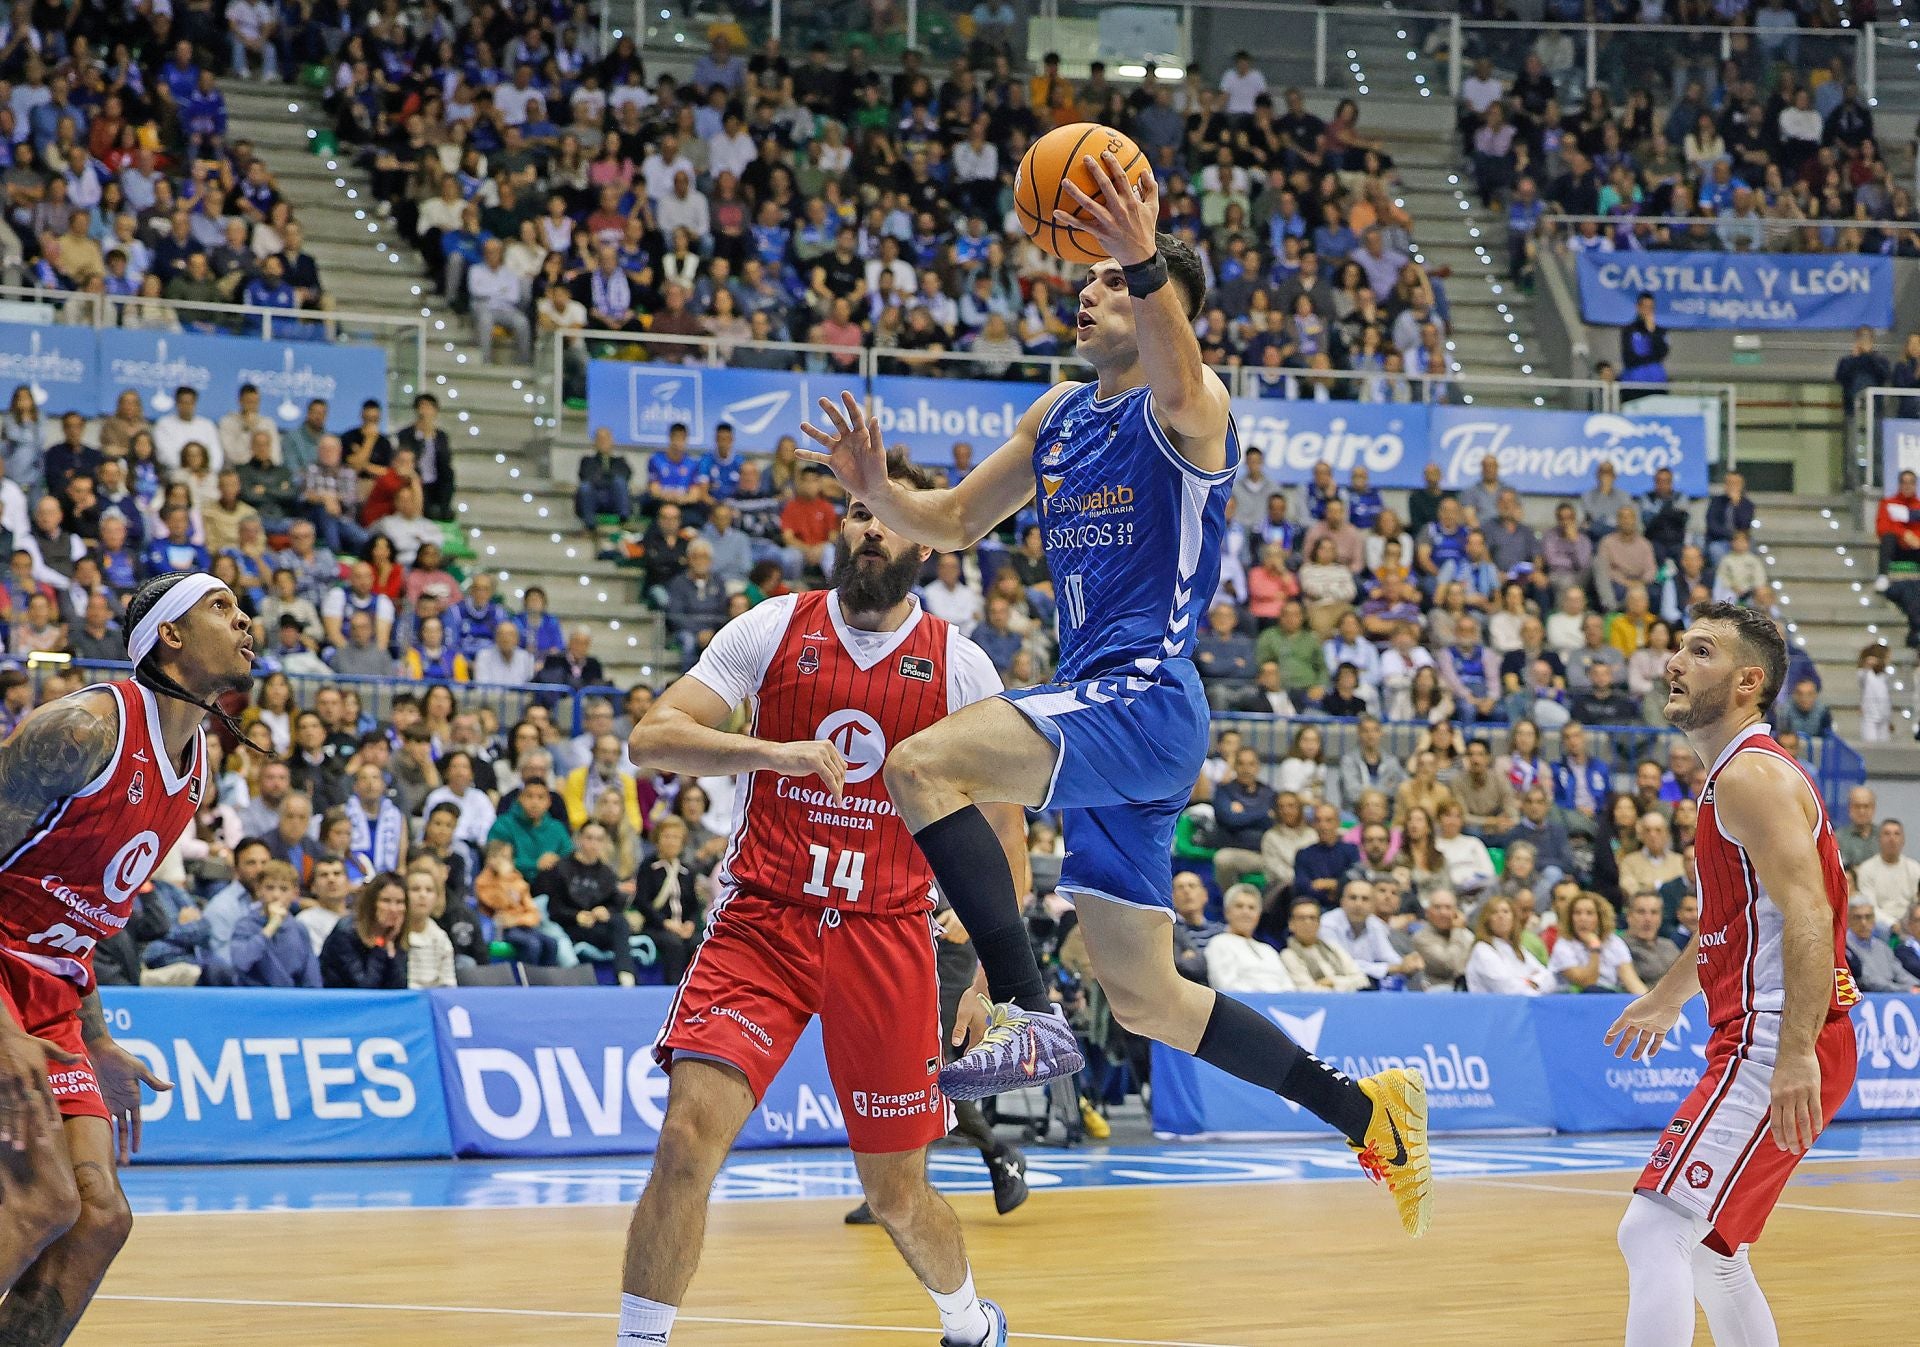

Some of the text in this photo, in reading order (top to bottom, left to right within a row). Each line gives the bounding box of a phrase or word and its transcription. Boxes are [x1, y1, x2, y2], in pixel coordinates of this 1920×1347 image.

[1599, 259, 1871, 298] CASTILLA Y LEÓN
[1117, 522, 1134, 533] 20
[1117, 534, 1134, 545] 31
[902, 668, 930, 679] endesa
[807, 810, 874, 831] ZARAGOZA
[802, 843, 866, 902] 14
[710, 1005, 773, 1047] azulmarino
[870, 1089, 926, 1107] Zaragoza
[871, 1102, 927, 1118] DEPORTE
[764, 1105, 794, 1140] by
